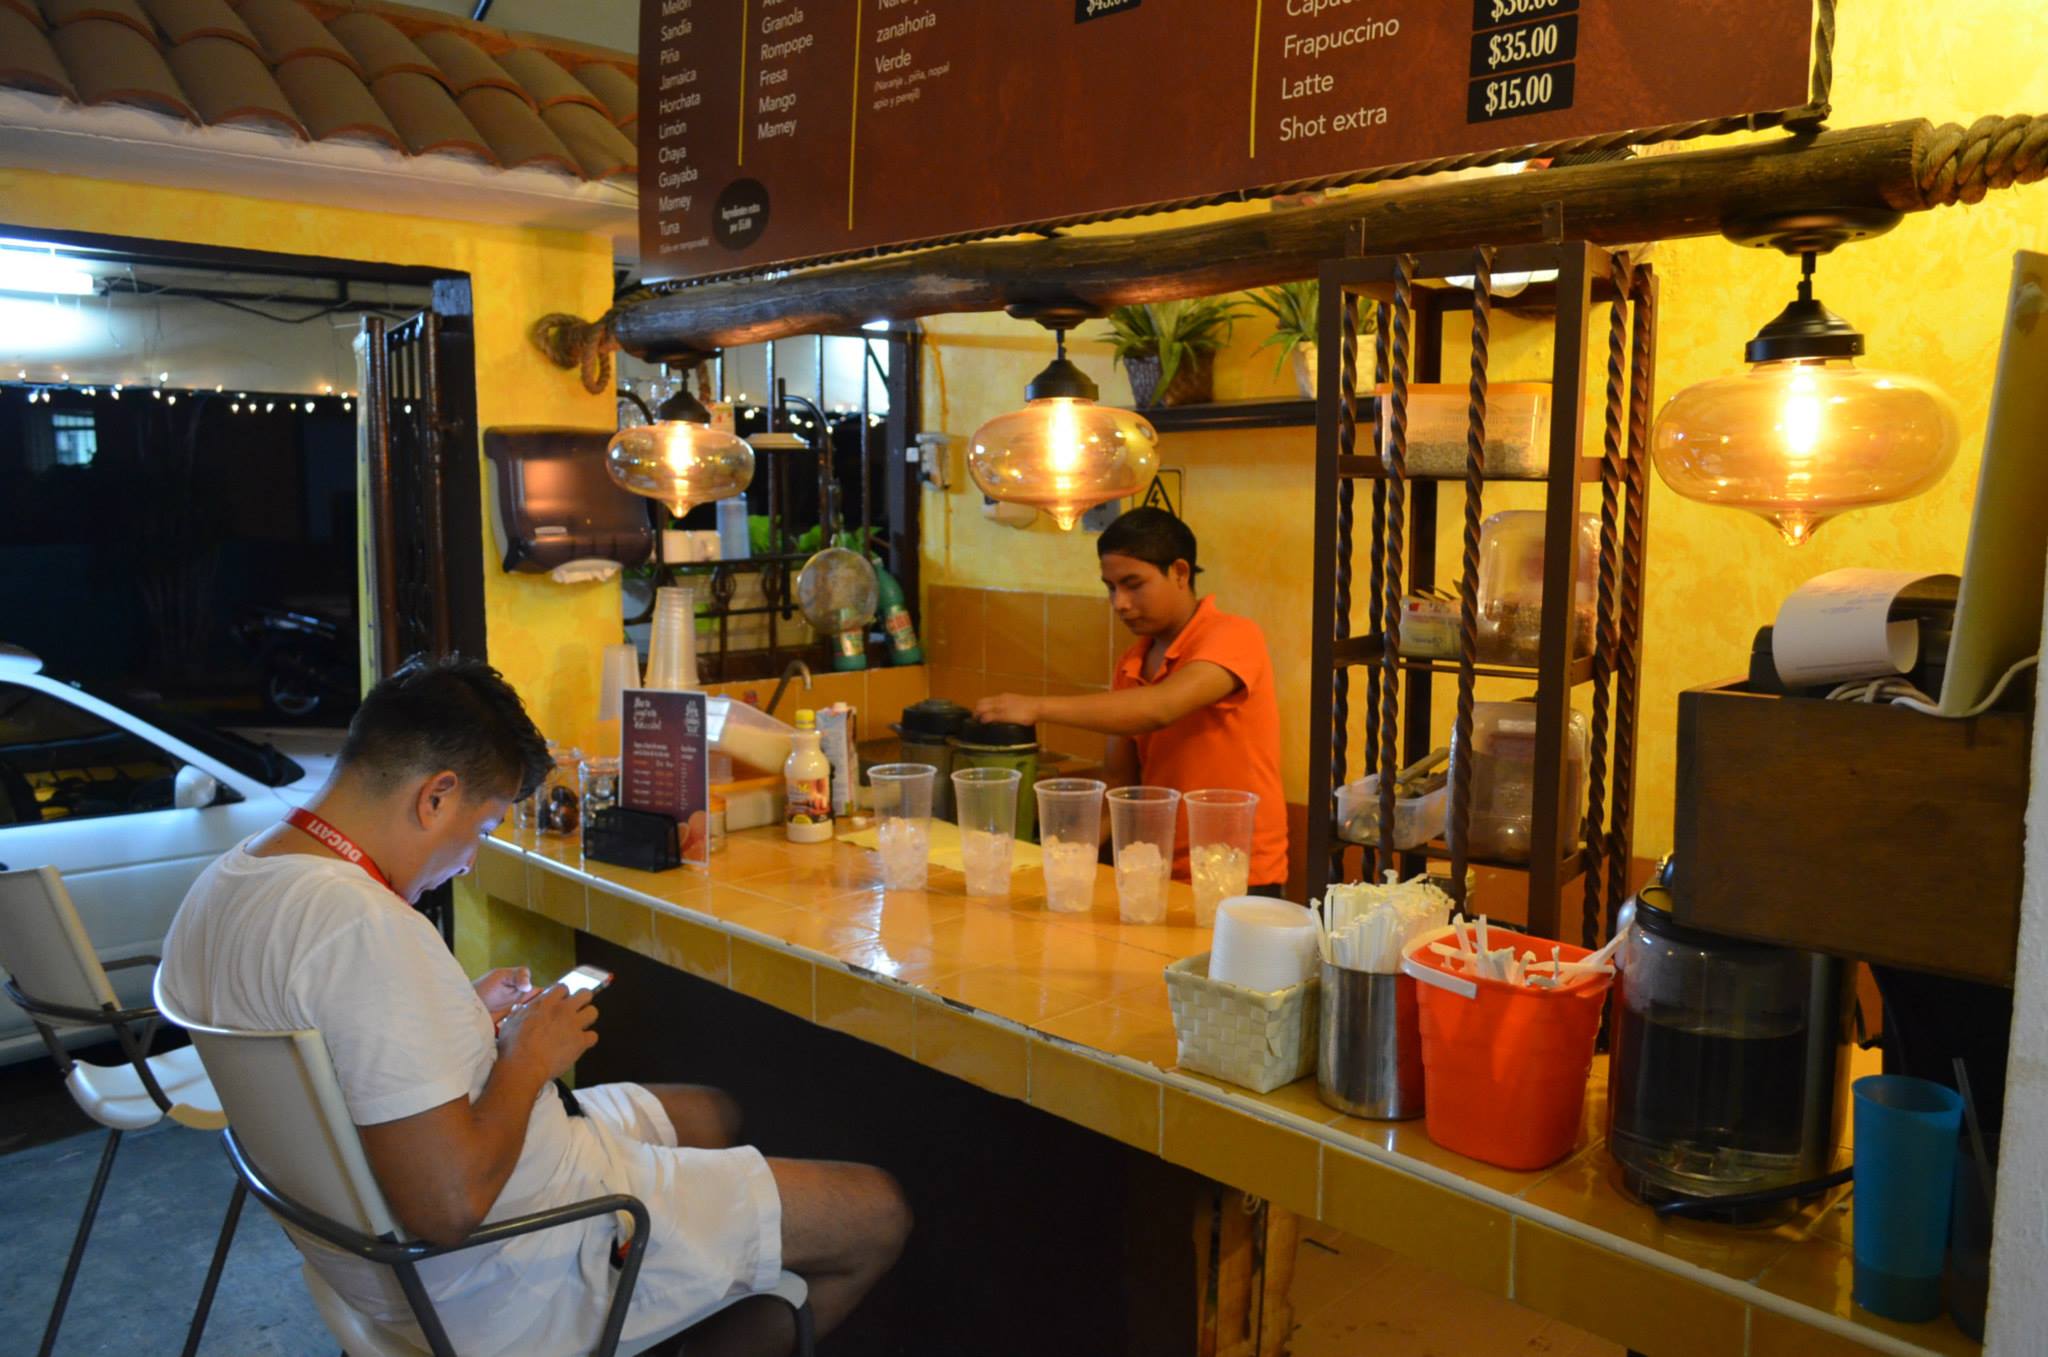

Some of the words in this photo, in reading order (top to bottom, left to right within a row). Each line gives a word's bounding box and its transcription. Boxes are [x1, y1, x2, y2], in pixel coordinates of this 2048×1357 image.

[762, 7, 804, 34] Granola
[876, 10, 936, 42] zanahoria
[761, 34, 814, 60] Rompope
[1284, 17, 1400, 59] Frapuccino
[1488, 24, 1558, 70] $35.00
[875, 48, 912, 73] Verde
[760, 69, 788, 86] Fresa
[1281, 74, 1334, 100] Latte
[659, 93, 701, 114] Horchata
[759, 93, 797, 113] Mango
[1485, 73, 1552, 117] $15.00
[758, 120, 797, 139] Mamey
[1279, 115, 1327, 141] Shot
[1333, 107, 1388, 132] extra
[659, 147, 687, 164] Chaya
[659, 166, 698, 188] Guayaba
[659, 221, 680, 236] Tuna
[306, 819, 362, 862] DUCATI
